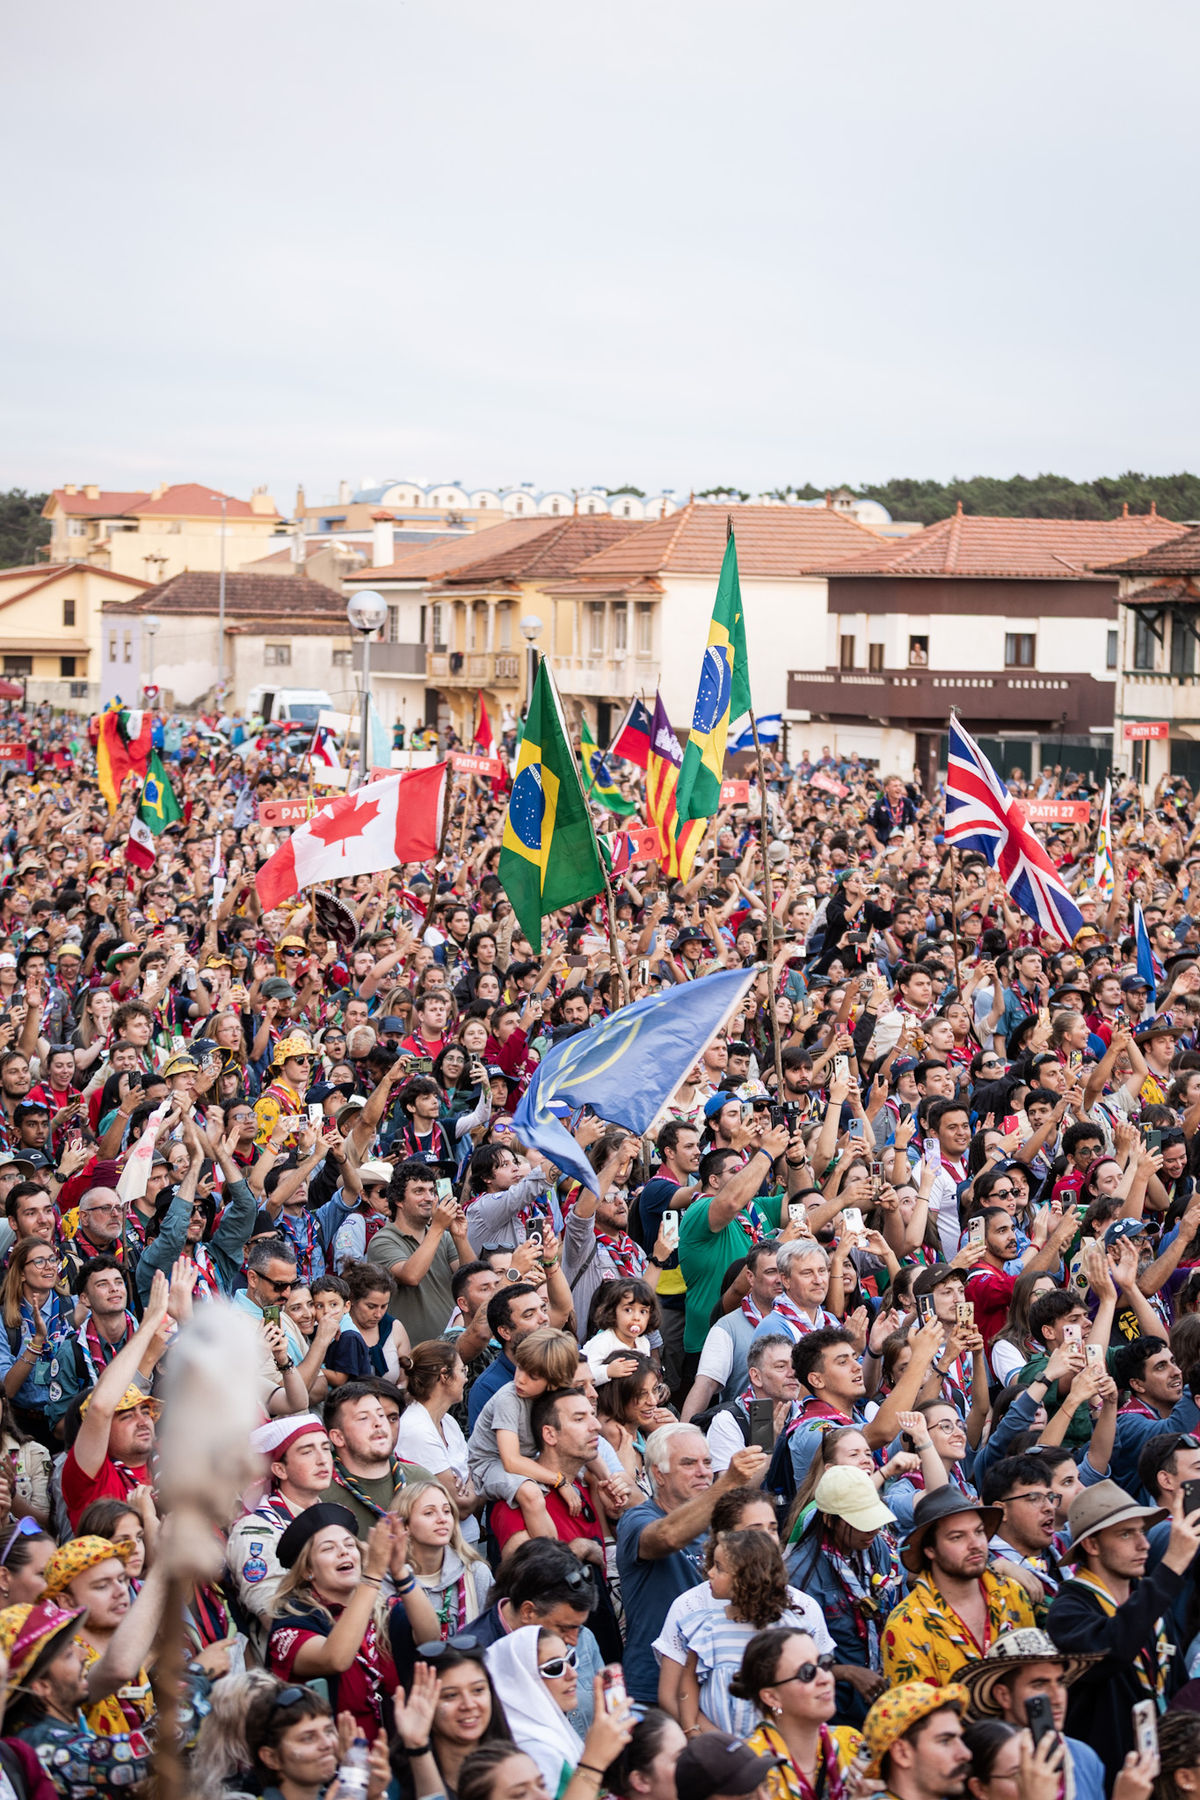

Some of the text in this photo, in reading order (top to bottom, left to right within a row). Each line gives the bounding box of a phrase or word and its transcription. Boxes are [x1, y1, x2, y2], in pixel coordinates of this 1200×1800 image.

[456, 757, 477, 769] PATH
[1029, 805, 1074, 817] PATH 27
